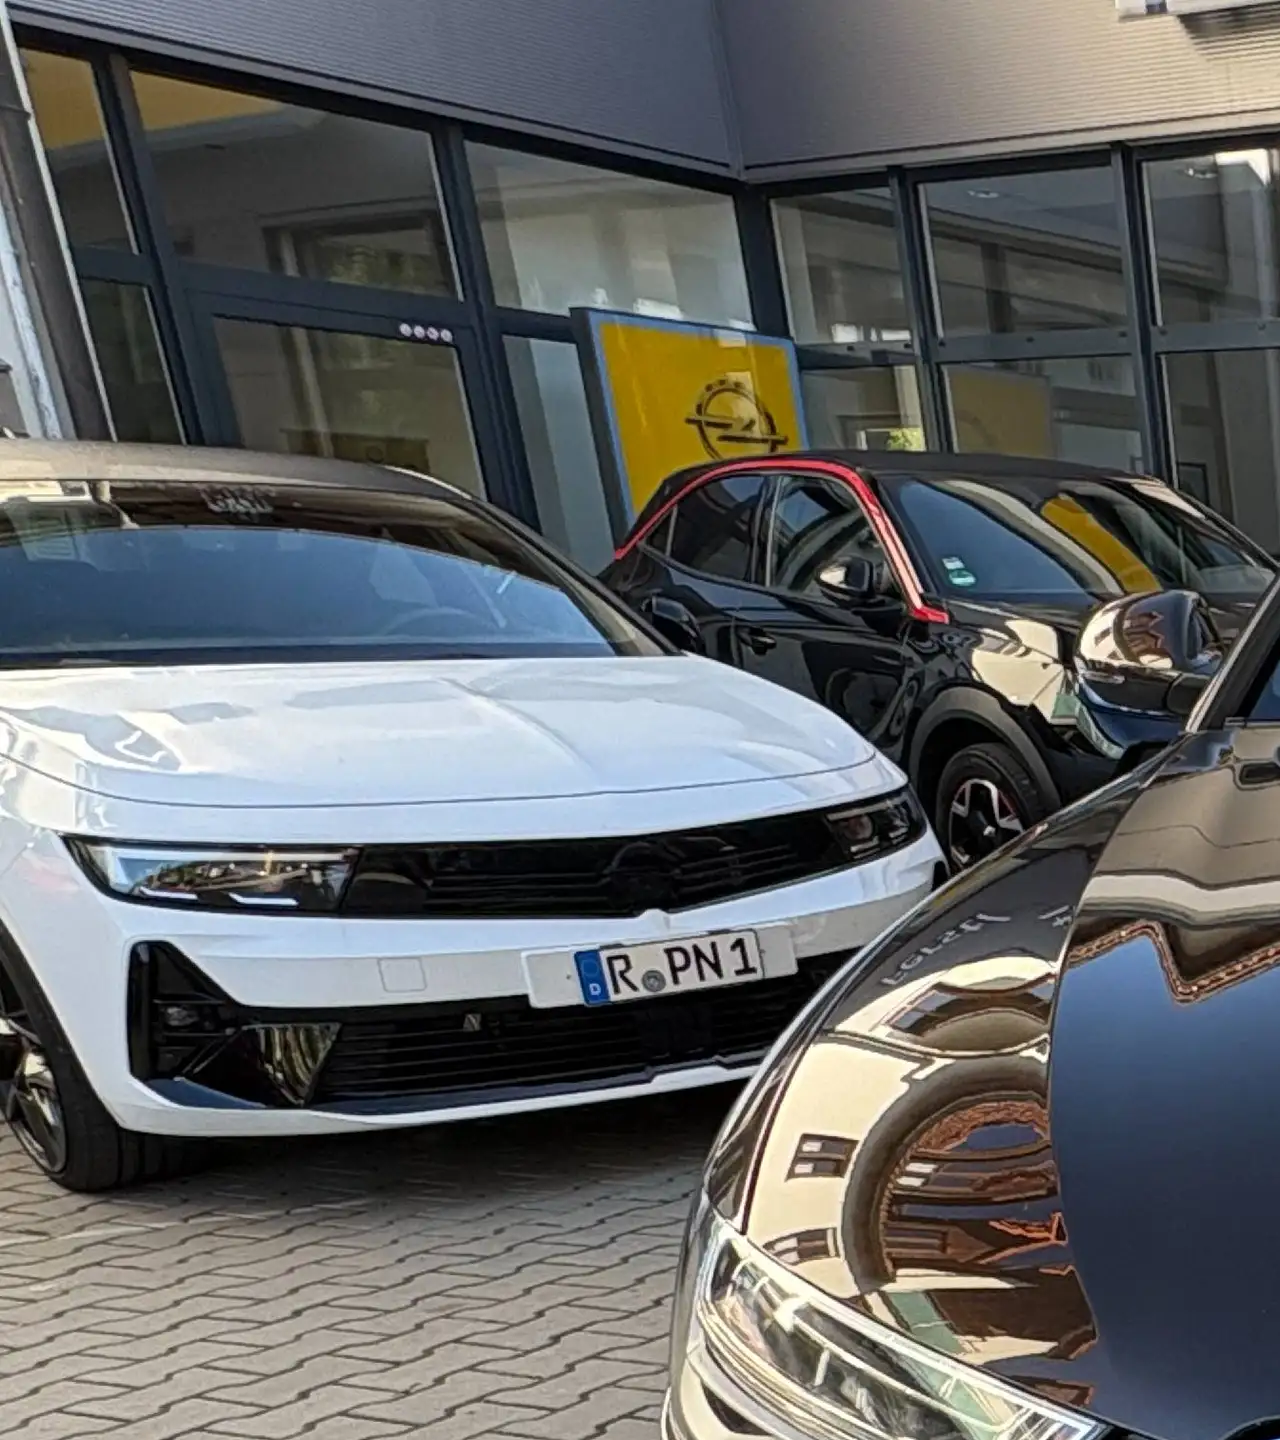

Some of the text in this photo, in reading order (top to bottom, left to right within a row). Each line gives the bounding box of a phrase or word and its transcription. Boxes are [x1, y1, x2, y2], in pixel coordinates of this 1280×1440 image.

[588, 937, 757, 996] D R PN 1
